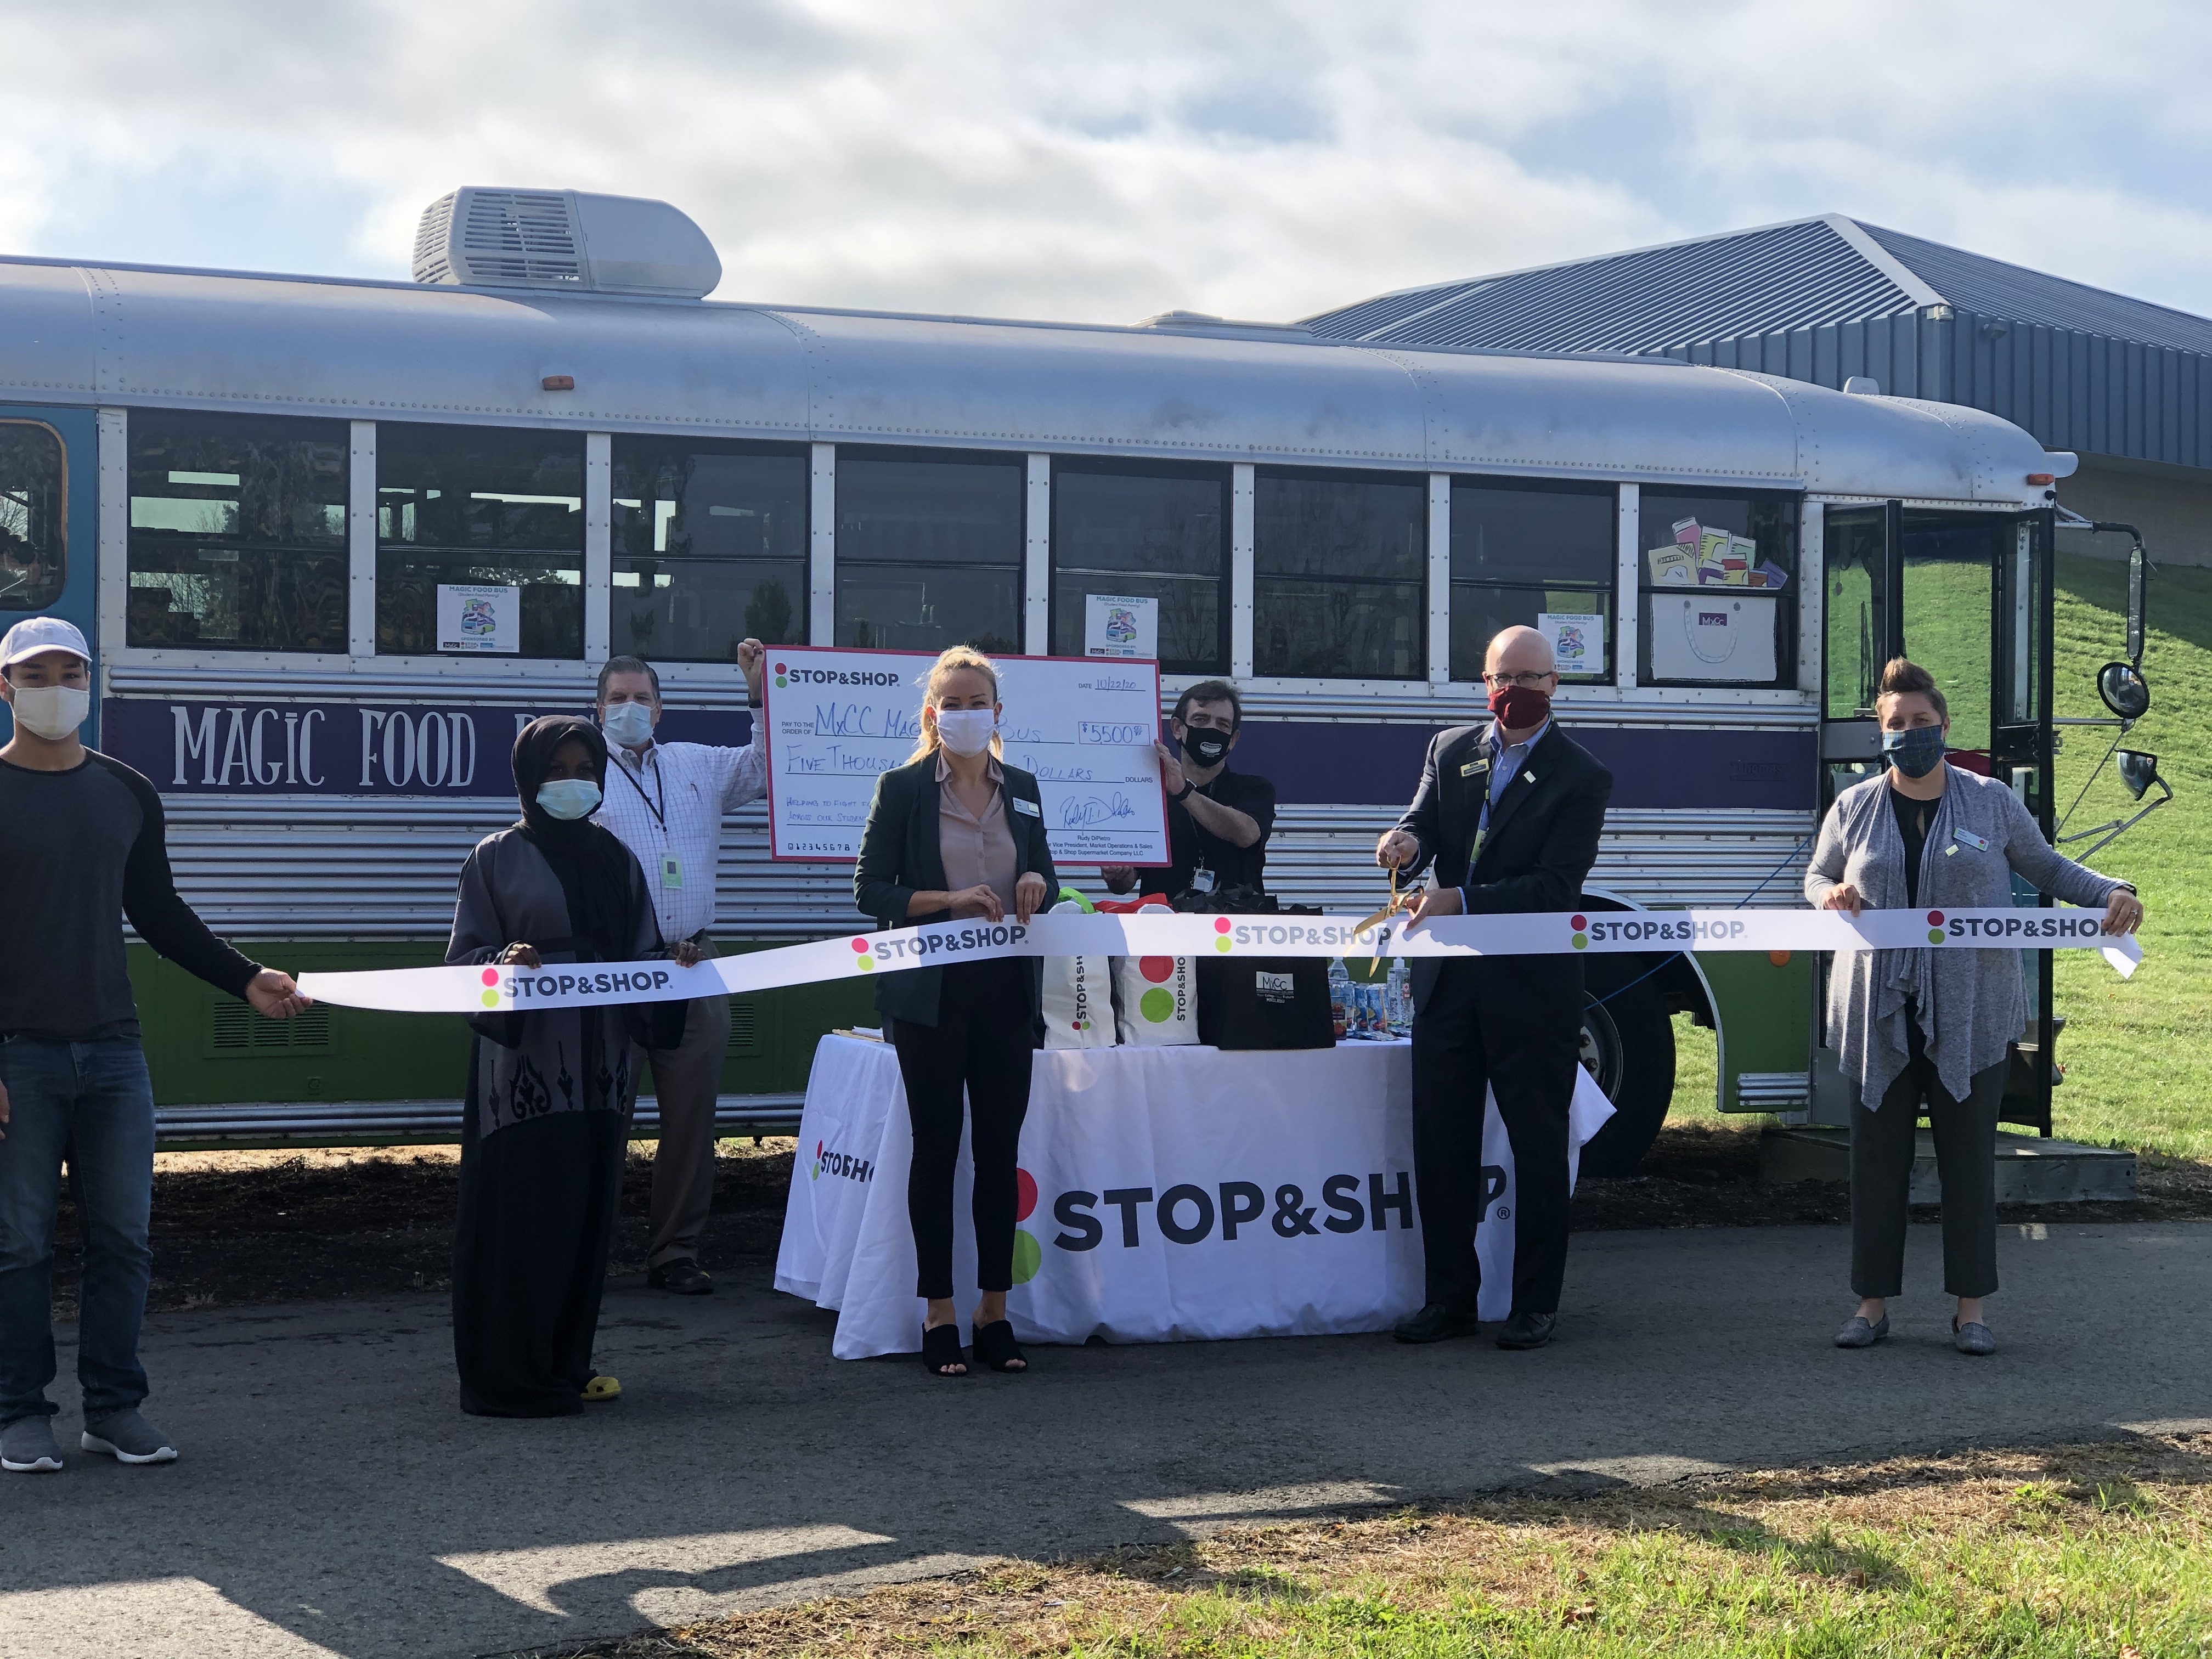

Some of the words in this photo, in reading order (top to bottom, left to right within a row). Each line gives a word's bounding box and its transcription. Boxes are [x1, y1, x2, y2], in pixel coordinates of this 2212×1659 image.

[789, 669, 899, 686] STOP&SHOP
[1097, 676, 1136, 692] 10/22/20
[884, 709, 921, 738] MAG
[359, 708, 475, 787] FOOD
[787, 745, 826, 772] FIVE
[827, 744, 902, 771] THOUSA
[1023, 755, 1093, 781] DOLLARS
[787, 797, 818, 806] HELPING
[874, 926, 1026, 960] STOP&SHOP
[1236, 926, 1391, 945] STOP&SHOP
[1591, 921, 1745, 941] STOP&SHOP
[504, 971, 669, 998] STOP&SHOP
[1076, 956, 1087, 1019] STOP&SH
[1177, 957, 1186, 1021] STOP&SHO
